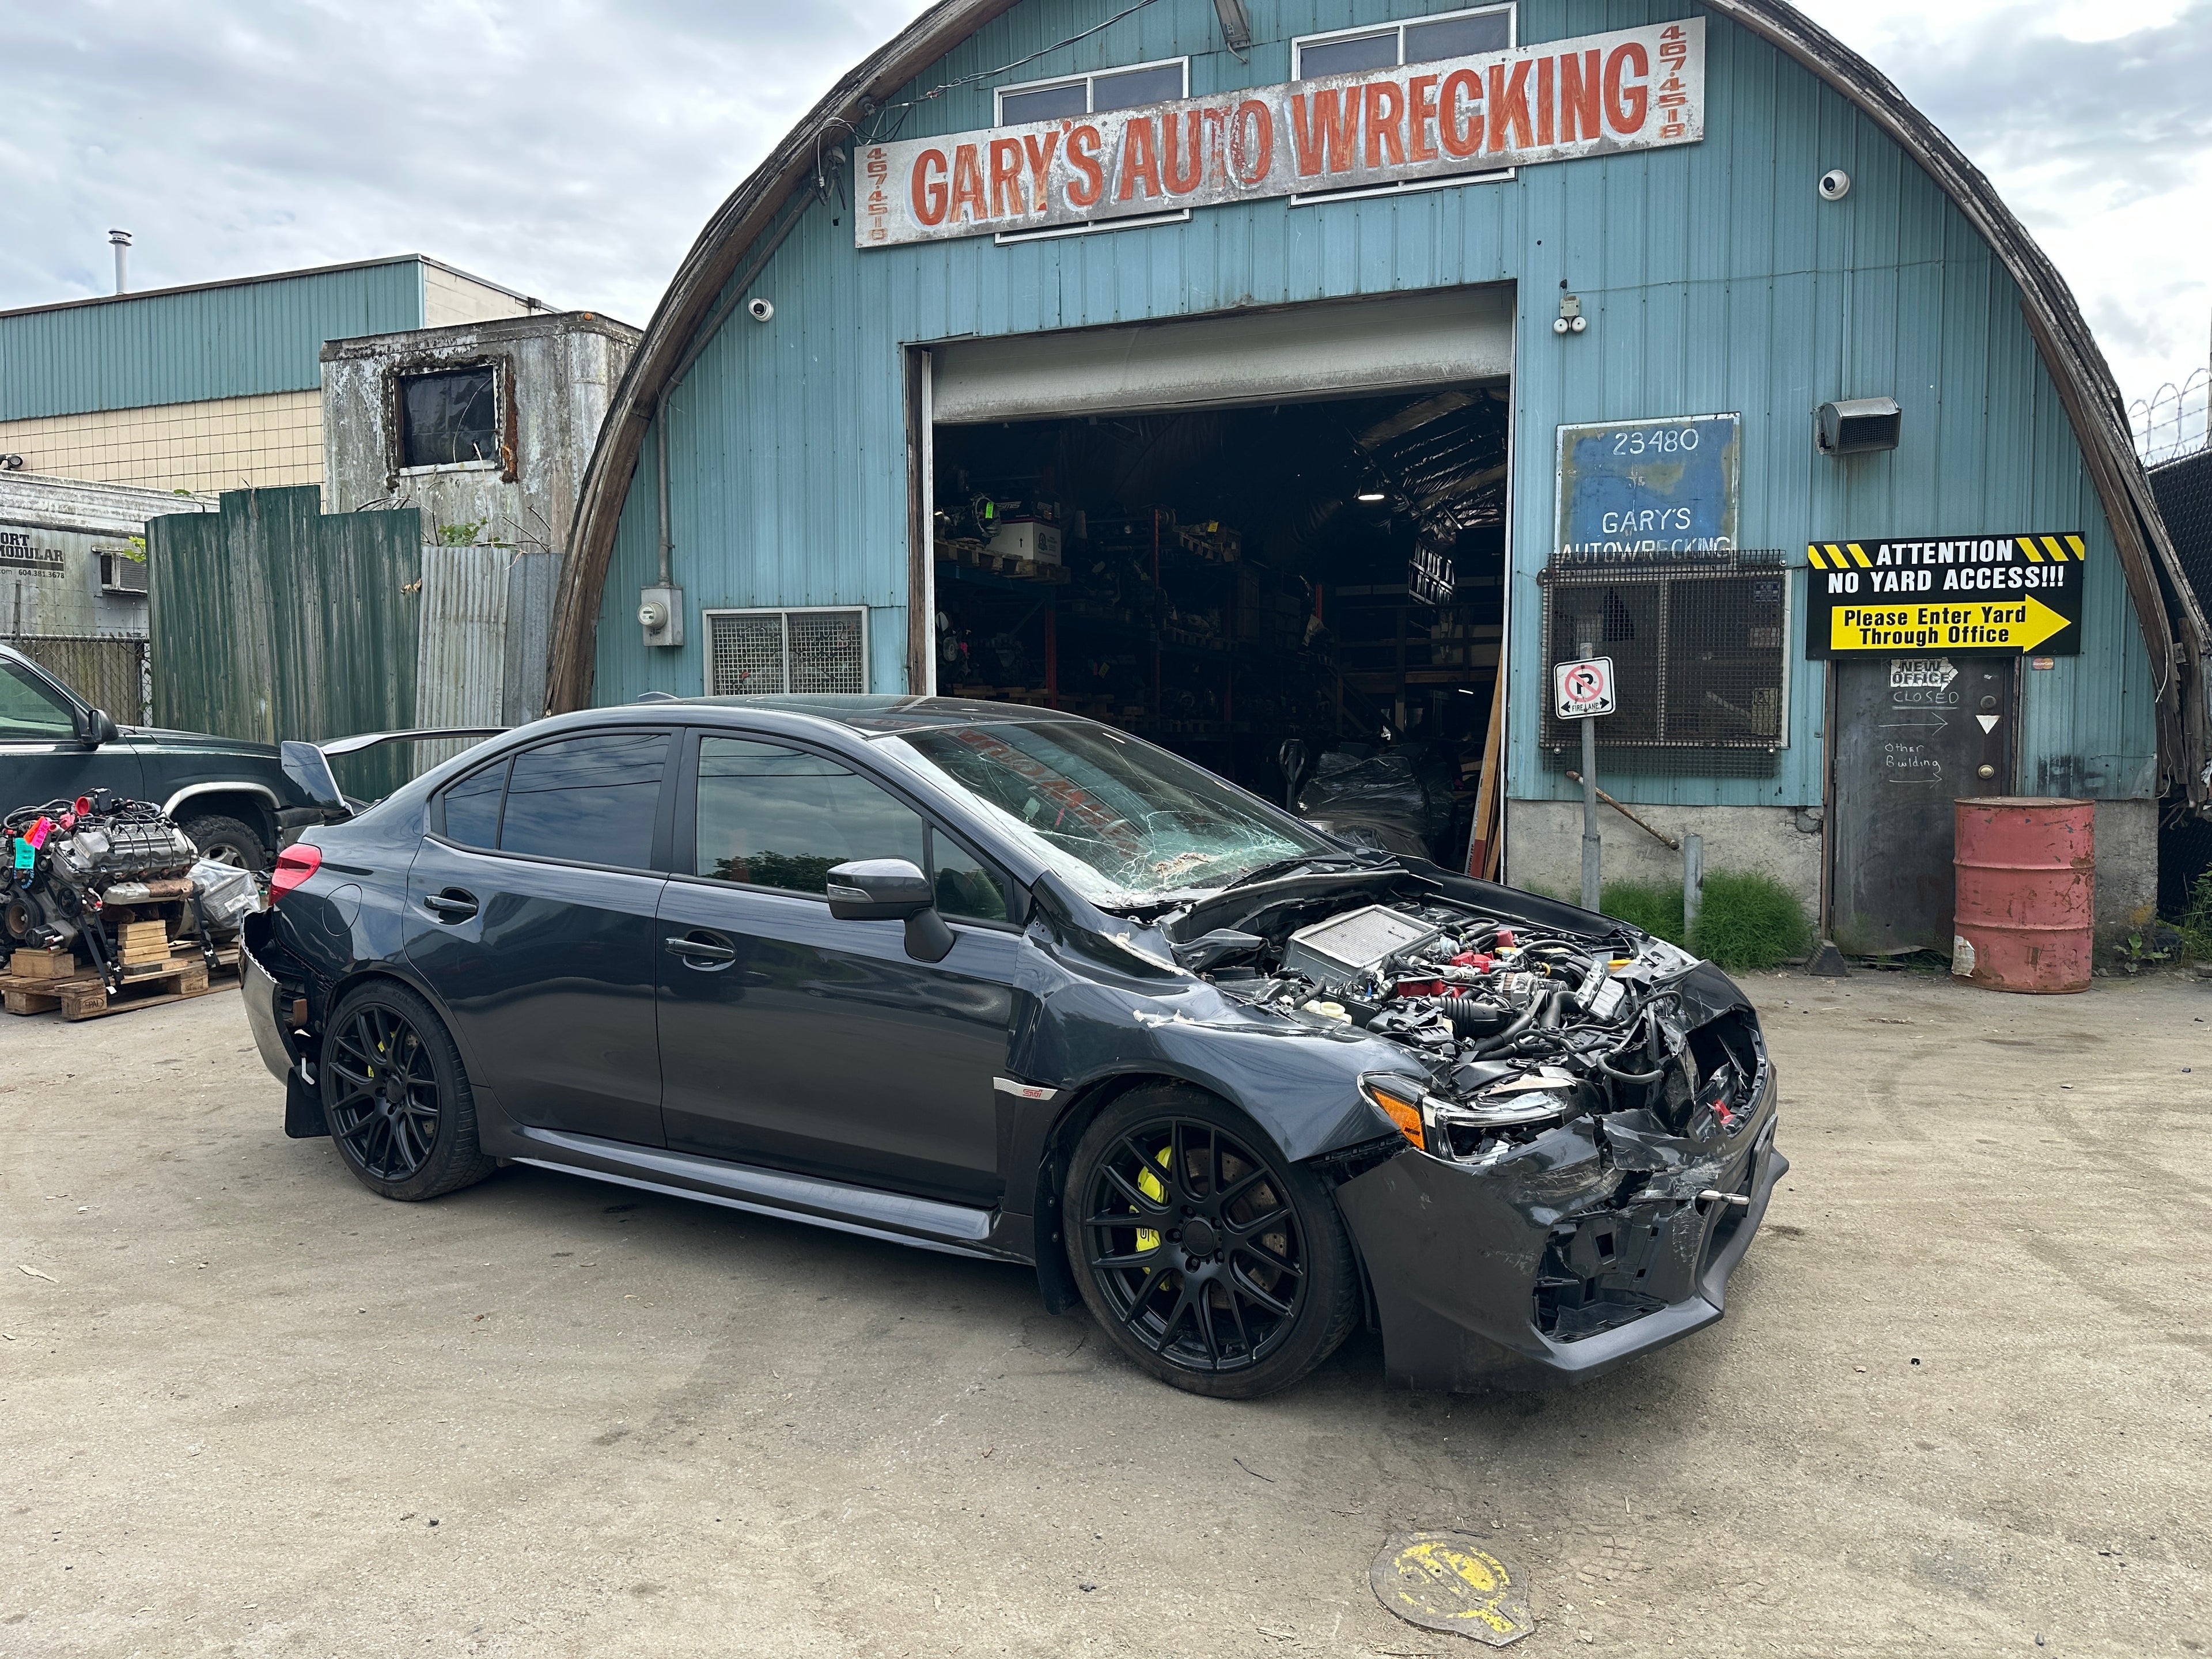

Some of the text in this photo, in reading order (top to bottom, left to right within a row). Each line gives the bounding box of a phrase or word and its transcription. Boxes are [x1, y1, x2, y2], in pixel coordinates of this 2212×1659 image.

[909, 42, 1649, 226] GARY'S AUTO WRECKING
[1613, 429, 1699, 455] 23480
[1603, 507, 1691, 533] GARY'S
[1876, 540, 2013, 566] ATTENTION
[18, 569, 65, 578] 604.381.3678
[1828, 565, 2065, 594] NO YARD ACCESS!!!
[1844, 605, 2026, 627] Please Enter Yard
[1859, 626, 2009, 646] Through Office
[1902, 661, 1941, 672] NEW
[1892, 672, 1949, 684] OFFICE
[1893, 691, 1959, 703] CLOSED
[1886, 755, 1941, 773] Building
